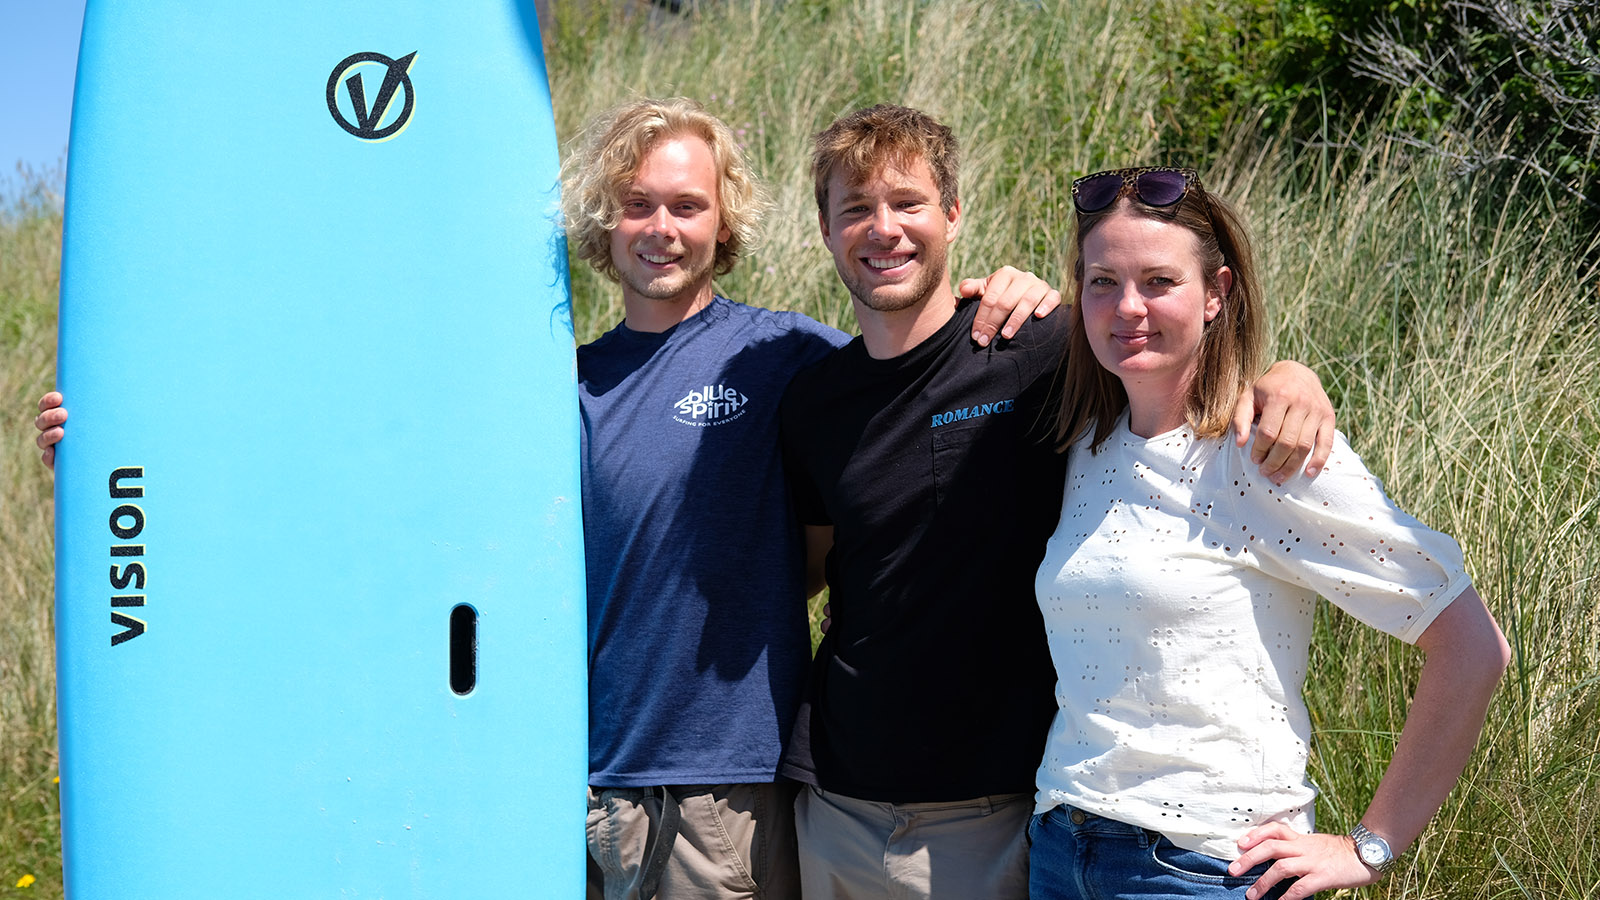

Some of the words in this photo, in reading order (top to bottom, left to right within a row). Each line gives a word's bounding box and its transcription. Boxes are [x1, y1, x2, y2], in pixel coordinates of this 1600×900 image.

[345, 50, 419, 139] V
[687, 384, 737, 404] blue
[672, 415, 697, 427] SURFING
[713, 409, 746, 426] EVERYONE
[679, 398, 740, 419] spirit
[930, 399, 1015, 428] ROMANCE
